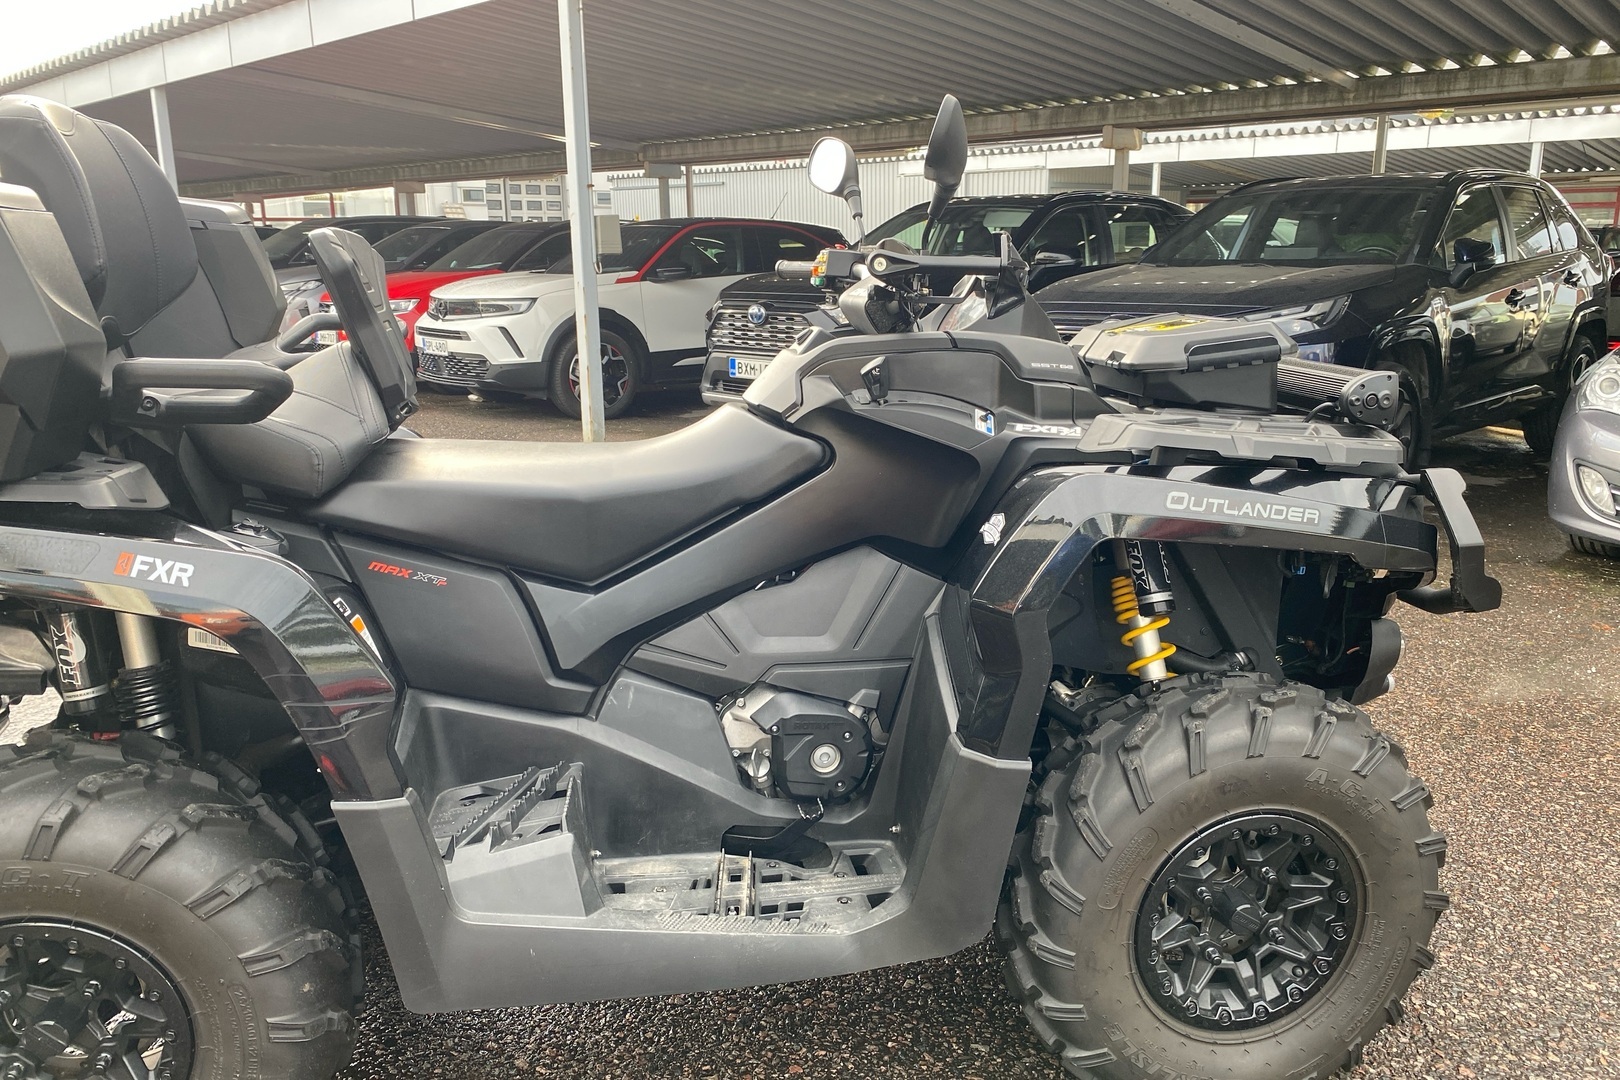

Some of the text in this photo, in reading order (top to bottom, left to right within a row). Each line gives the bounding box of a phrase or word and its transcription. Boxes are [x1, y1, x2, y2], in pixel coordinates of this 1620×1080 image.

[737, 361, 769, 376] BXM-1
[130, 554, 195, 588] FXR
[368, 561, 413, 578] MAX
[1126, 540, 1150, 590] FOX
[50, 623, 82, 685] FOX
